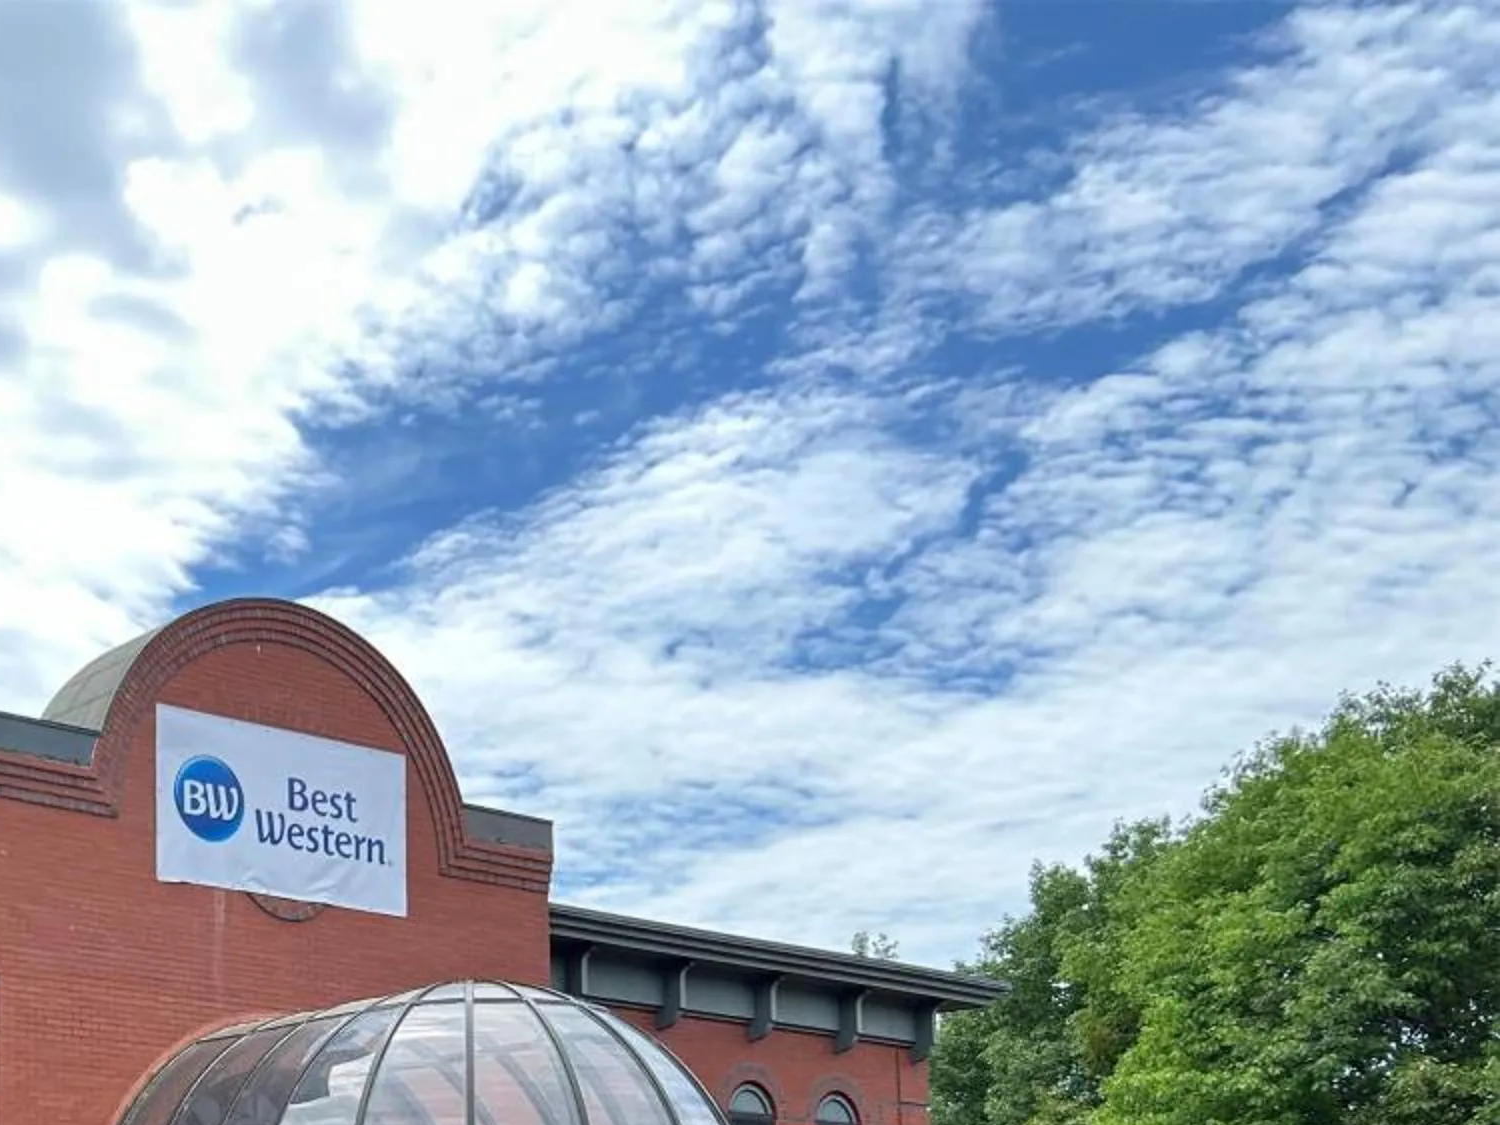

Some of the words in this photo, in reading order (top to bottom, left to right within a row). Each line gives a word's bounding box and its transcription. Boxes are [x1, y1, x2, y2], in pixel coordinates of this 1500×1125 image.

[183, 779, 239, 821] BW
[287, 777, 358, 823] Best
[255, 808, 385, 866] Western
